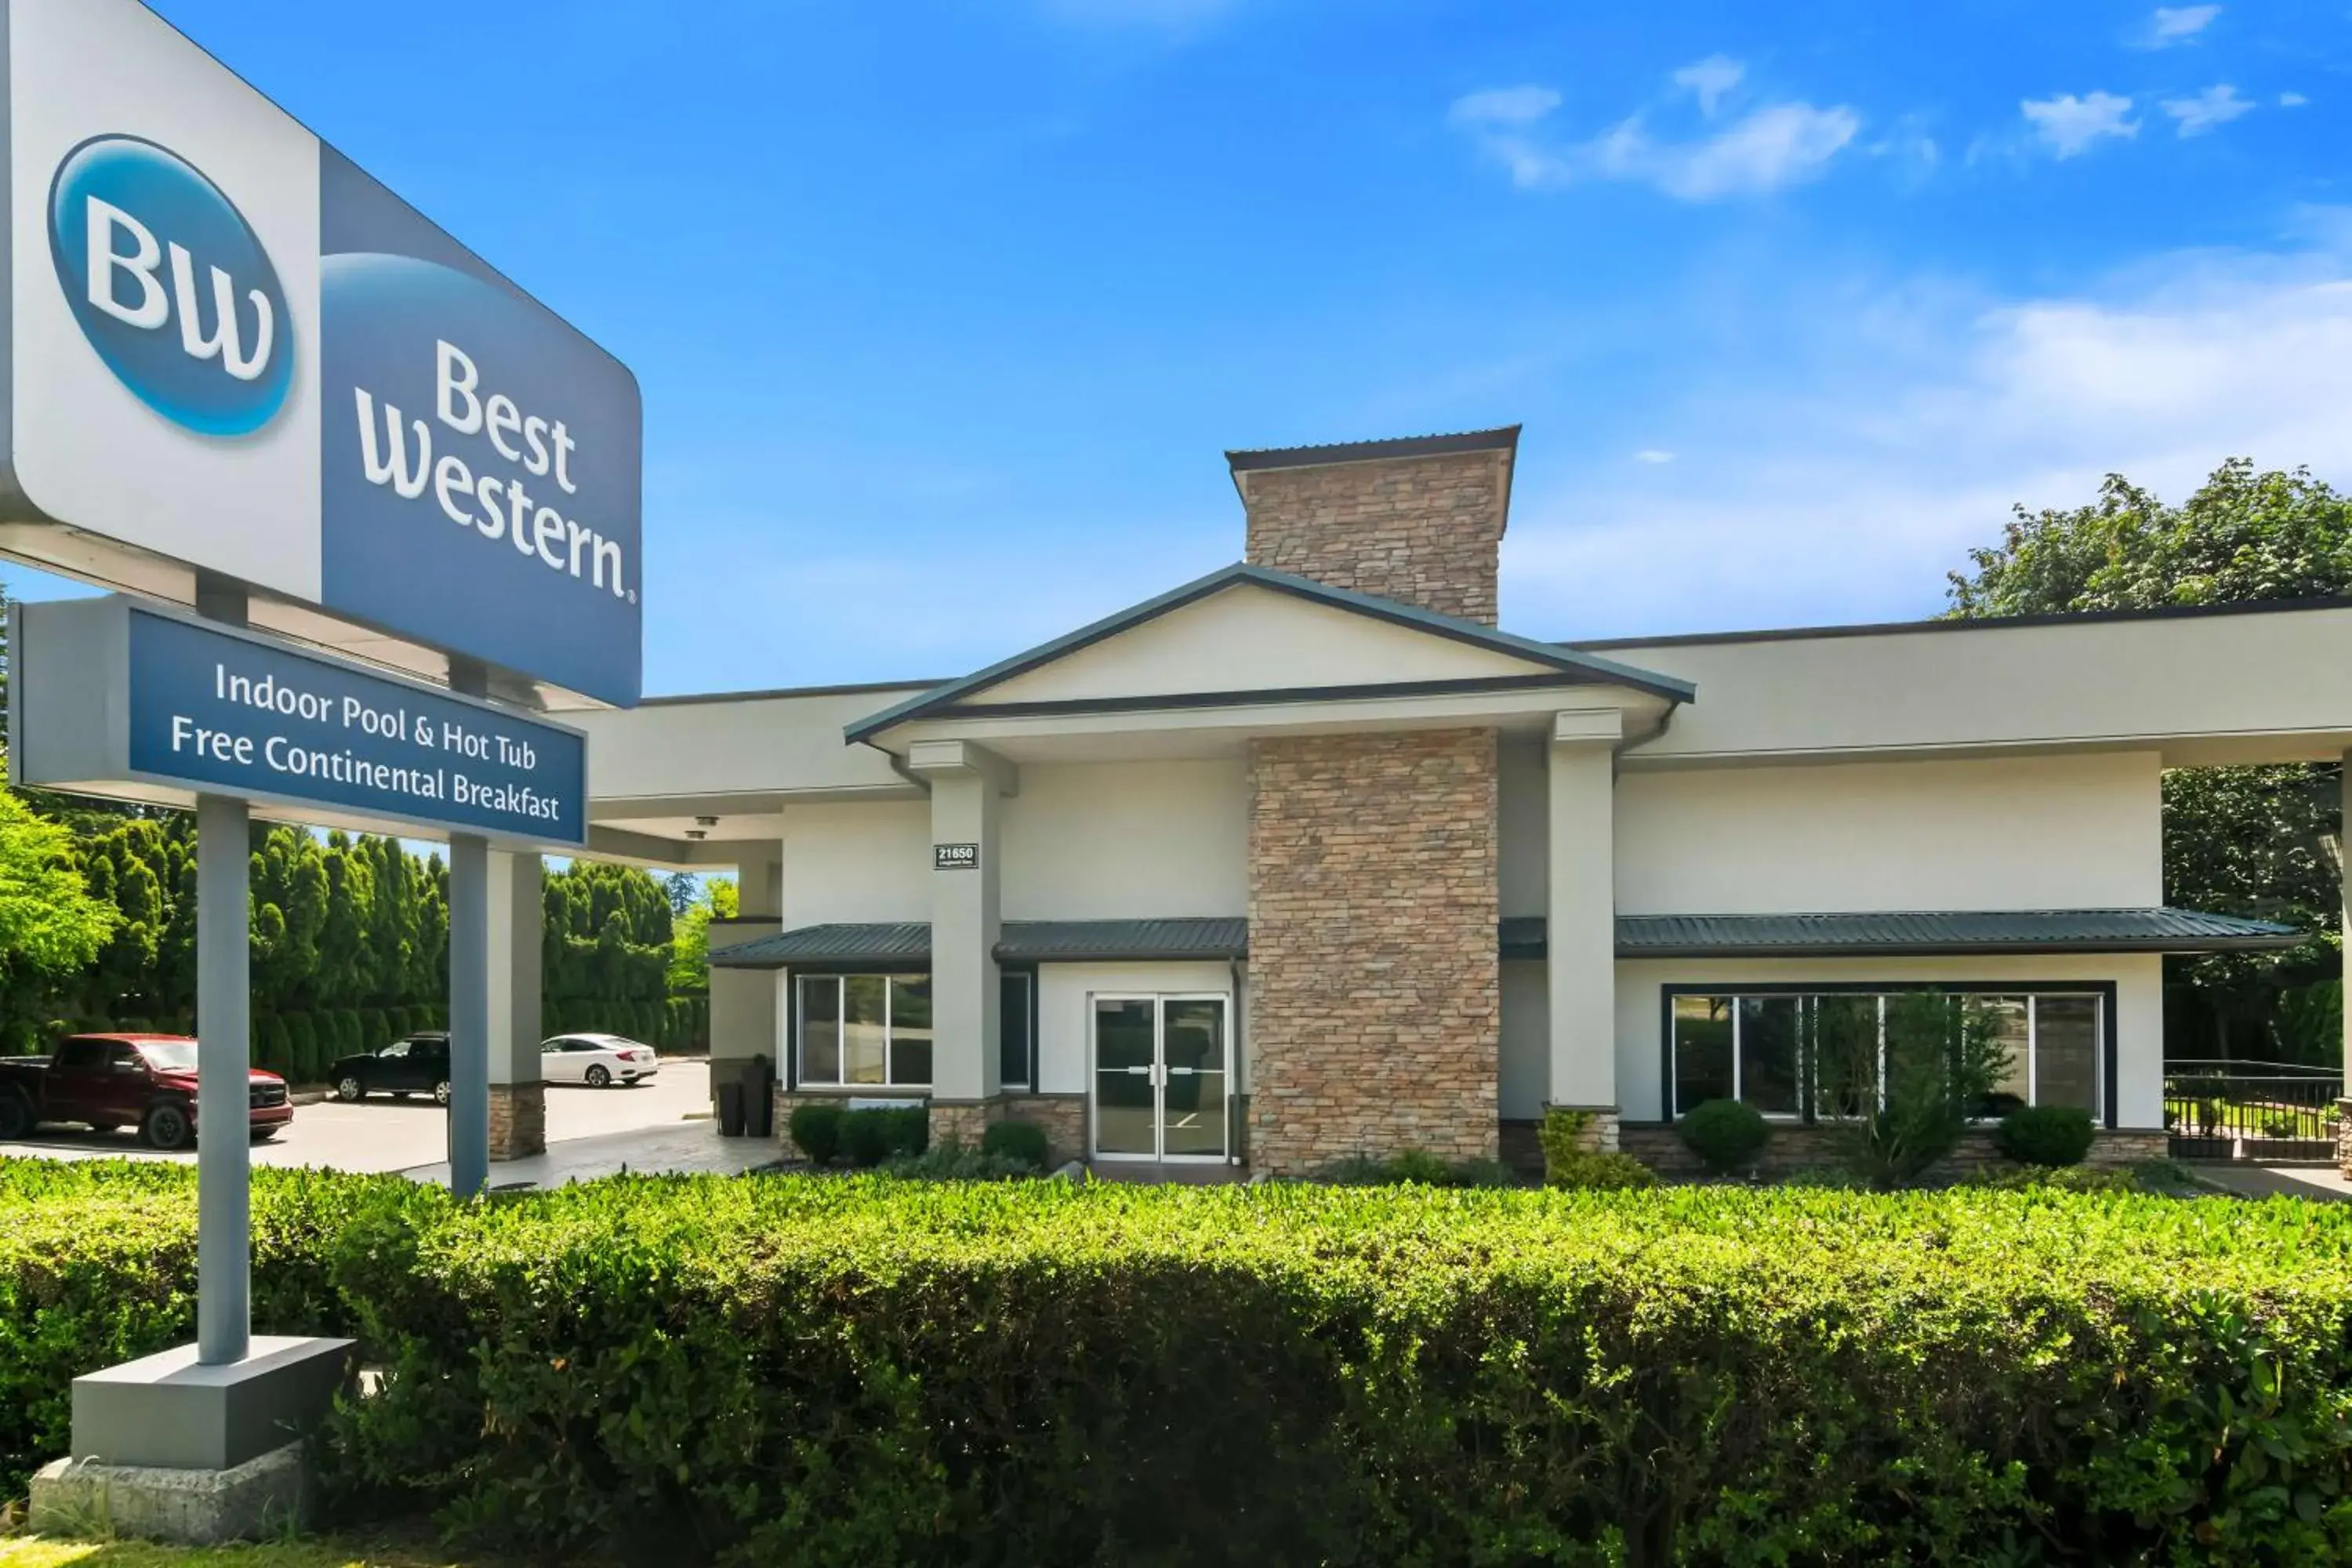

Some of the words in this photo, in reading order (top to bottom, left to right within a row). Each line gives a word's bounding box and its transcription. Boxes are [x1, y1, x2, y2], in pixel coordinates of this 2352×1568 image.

[87, 194, 274, 381] BW
[437, 339, 576, 494] Best
[354, 387, 626, 600] Western
[172, 716, 253, 764] Free
[265, 736, 445, 800] Continental
[453, 773, 559, 821] Breakfast
[216, 663, 333, 721] Indoor
[343, 697, 405, 741] Pool
[414, 715, 434, 746] &
[443, 722, 488, 758] Hot
[495, 735, 535, 771] Tub
[939, 848, 973, 859] 21650
